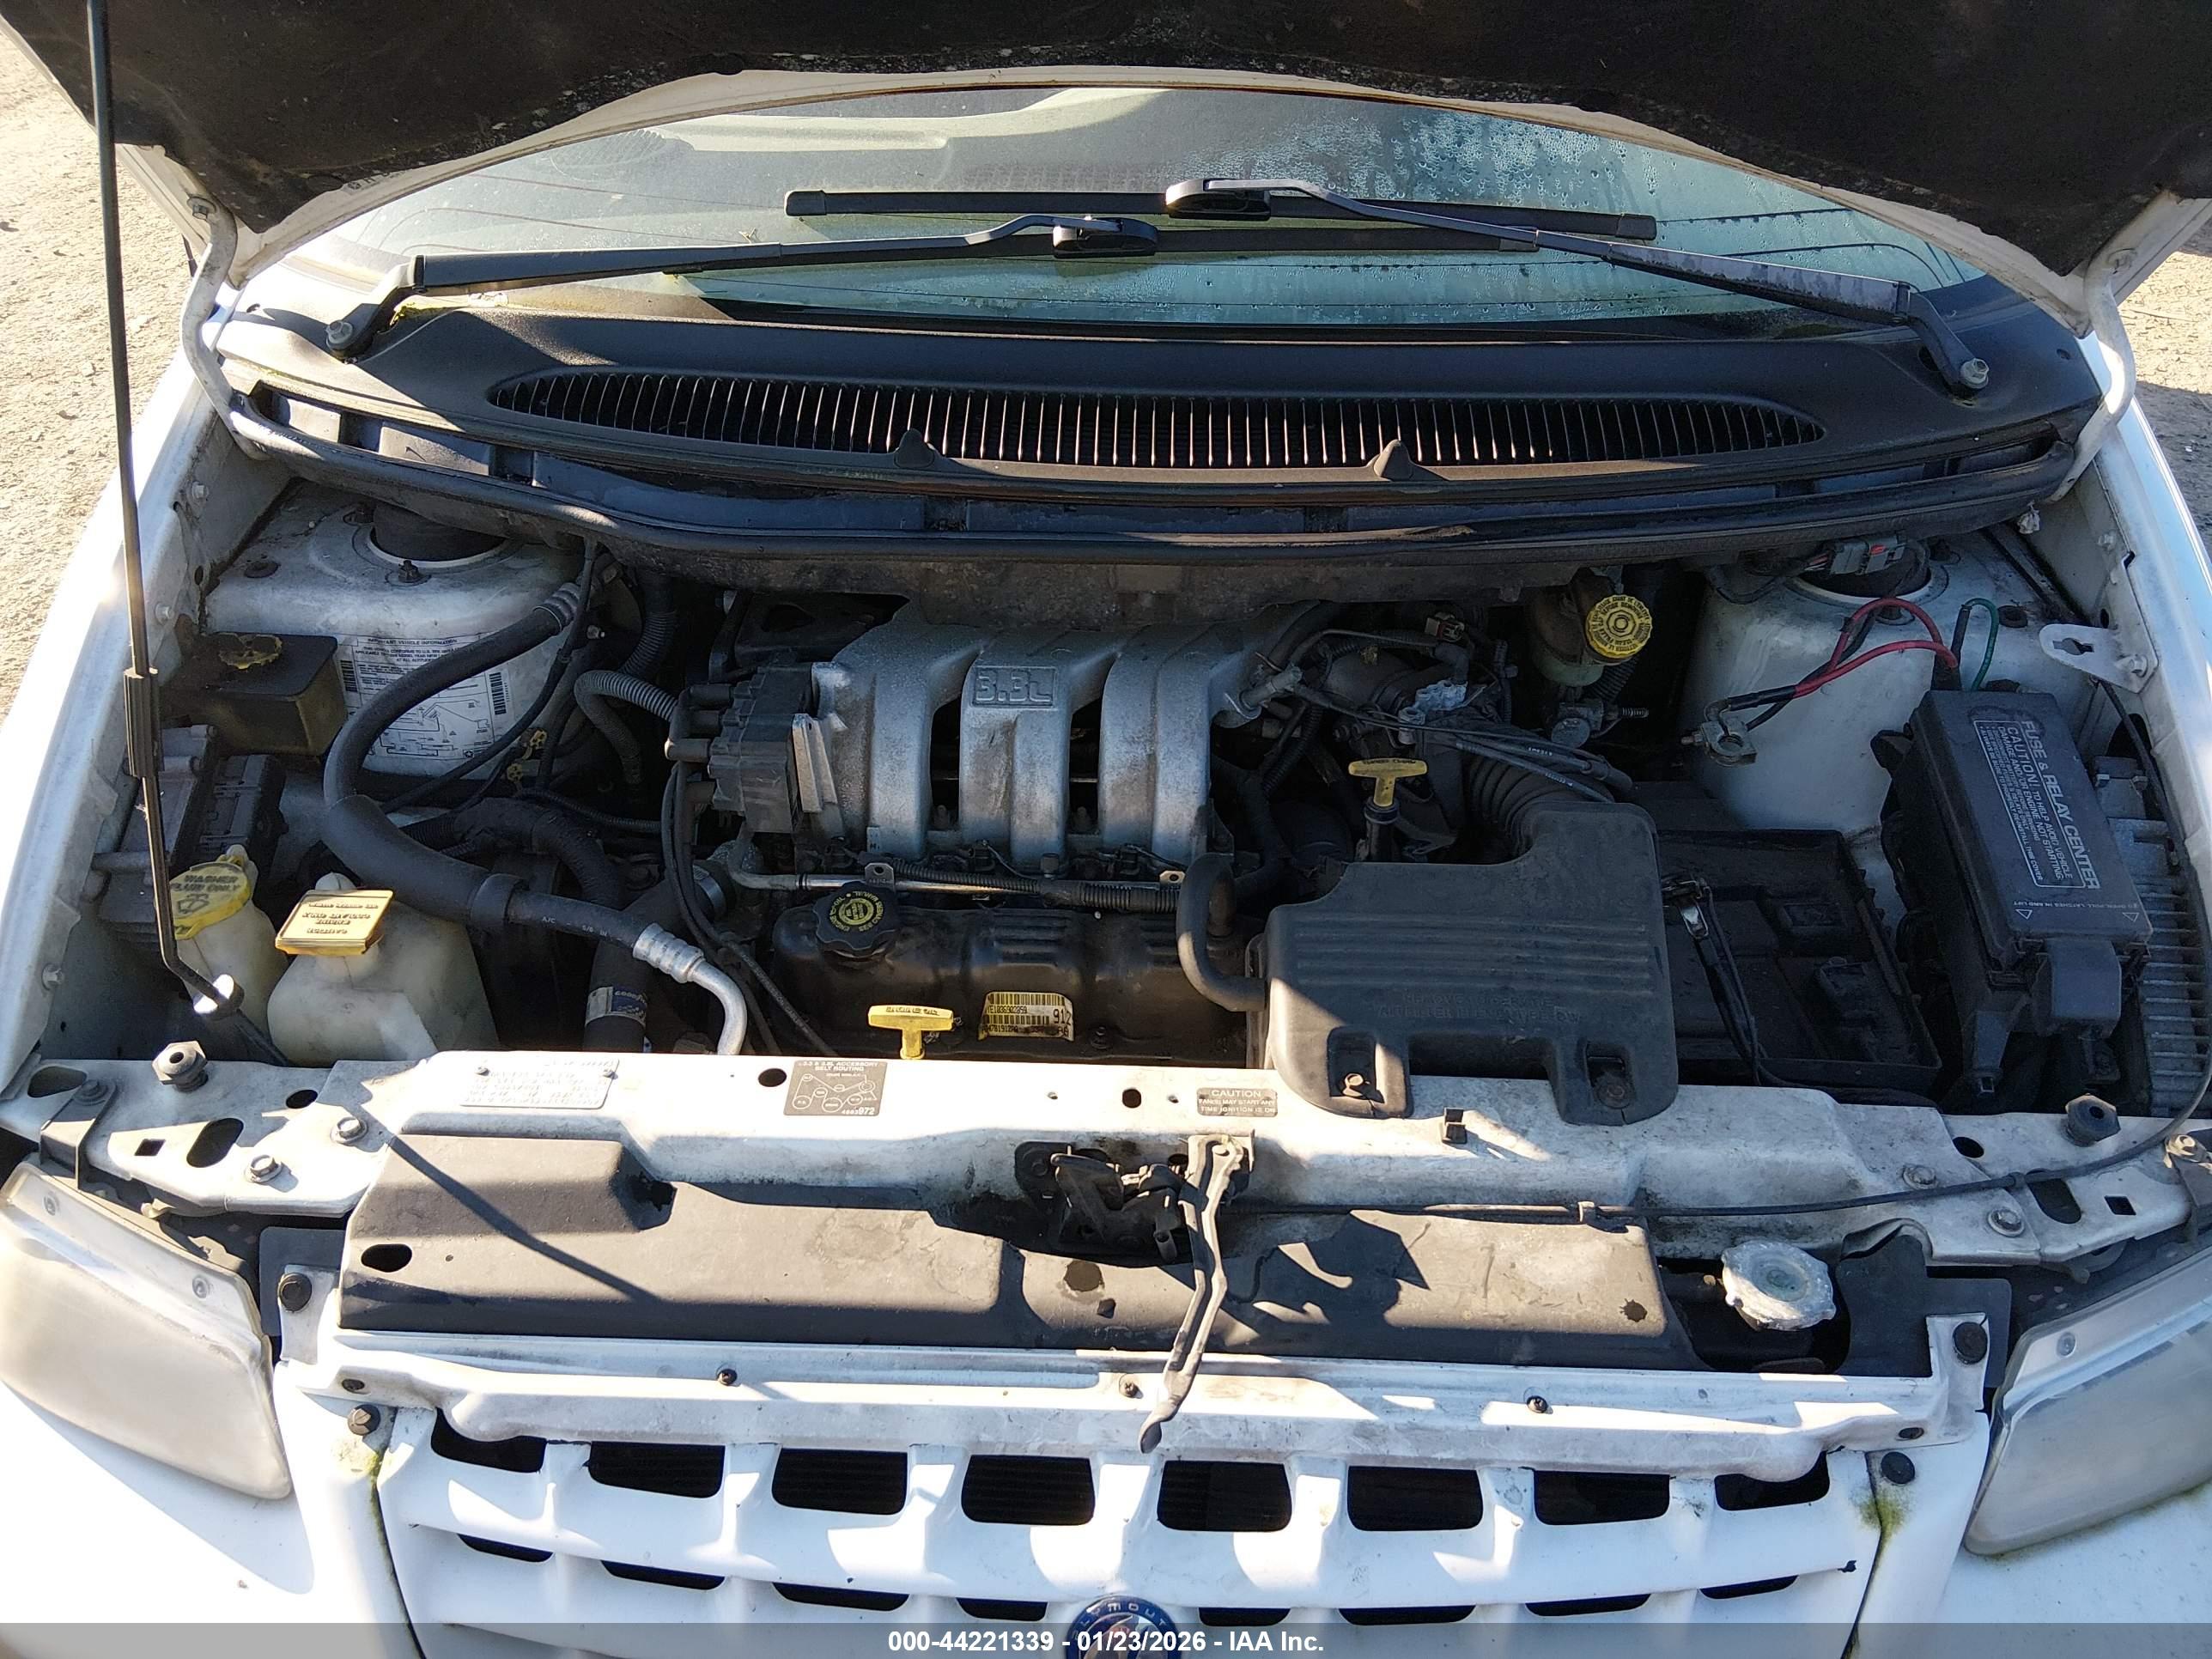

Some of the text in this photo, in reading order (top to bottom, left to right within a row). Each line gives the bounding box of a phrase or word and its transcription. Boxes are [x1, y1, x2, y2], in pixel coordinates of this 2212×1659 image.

[975, 669, 1052, 702] 3.3L
[1996, 726, 2016, 757] DAMAGE
[2009, 758, 2029, 788] AND/OR
[2023, 791, 2041, 818] ENGINE
[2034, 822, 2047, 837] NOT
[2007, 726, 2073, 878] CAUTION! TO HELP AVOID VEHICLE
[2021, 720, 2048, 757] FUSE
[2043, 775, 2073, 821] RELAY
[2063, 824, 2100, 890] CENTER
[2030, 860, 2042, 880] COVER
[1053, 1008, 1072, 1025] 912
[1073, 1601, 1174, 1642] PLYMOUT
